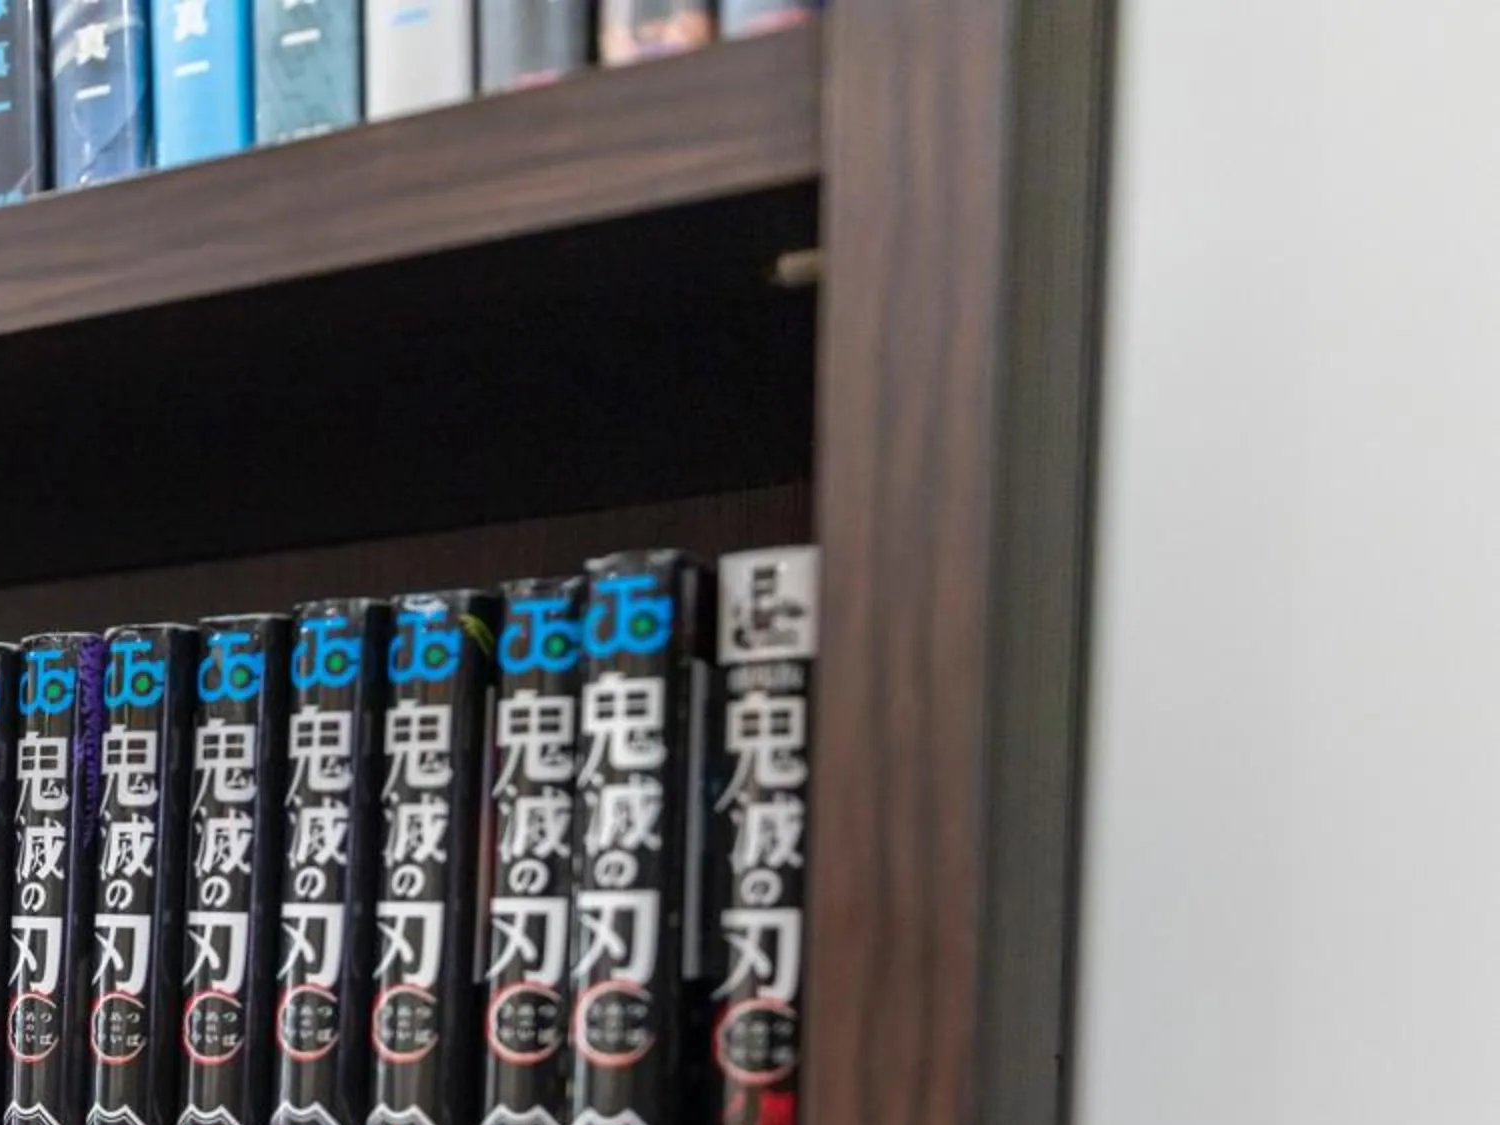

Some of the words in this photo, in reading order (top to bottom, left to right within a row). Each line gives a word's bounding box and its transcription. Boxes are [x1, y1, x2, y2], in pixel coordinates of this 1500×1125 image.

[7, 731, 68, 996] 鬼滅の刃
[93, 725, 158, 996] 鬼滅の刃
[184, 717, 258, 993] 鬼滅の刃
[278, 704, 352, 991] 鬼滅の刃
[373, 700, 452, 989] 鬼滅の刃
[485, 690, 574, 986] 鬼滅の刃
[571, 672, 668, 985] 鬼滅の刃
[712, 692, 809, 1000] 鬼滅の刃
